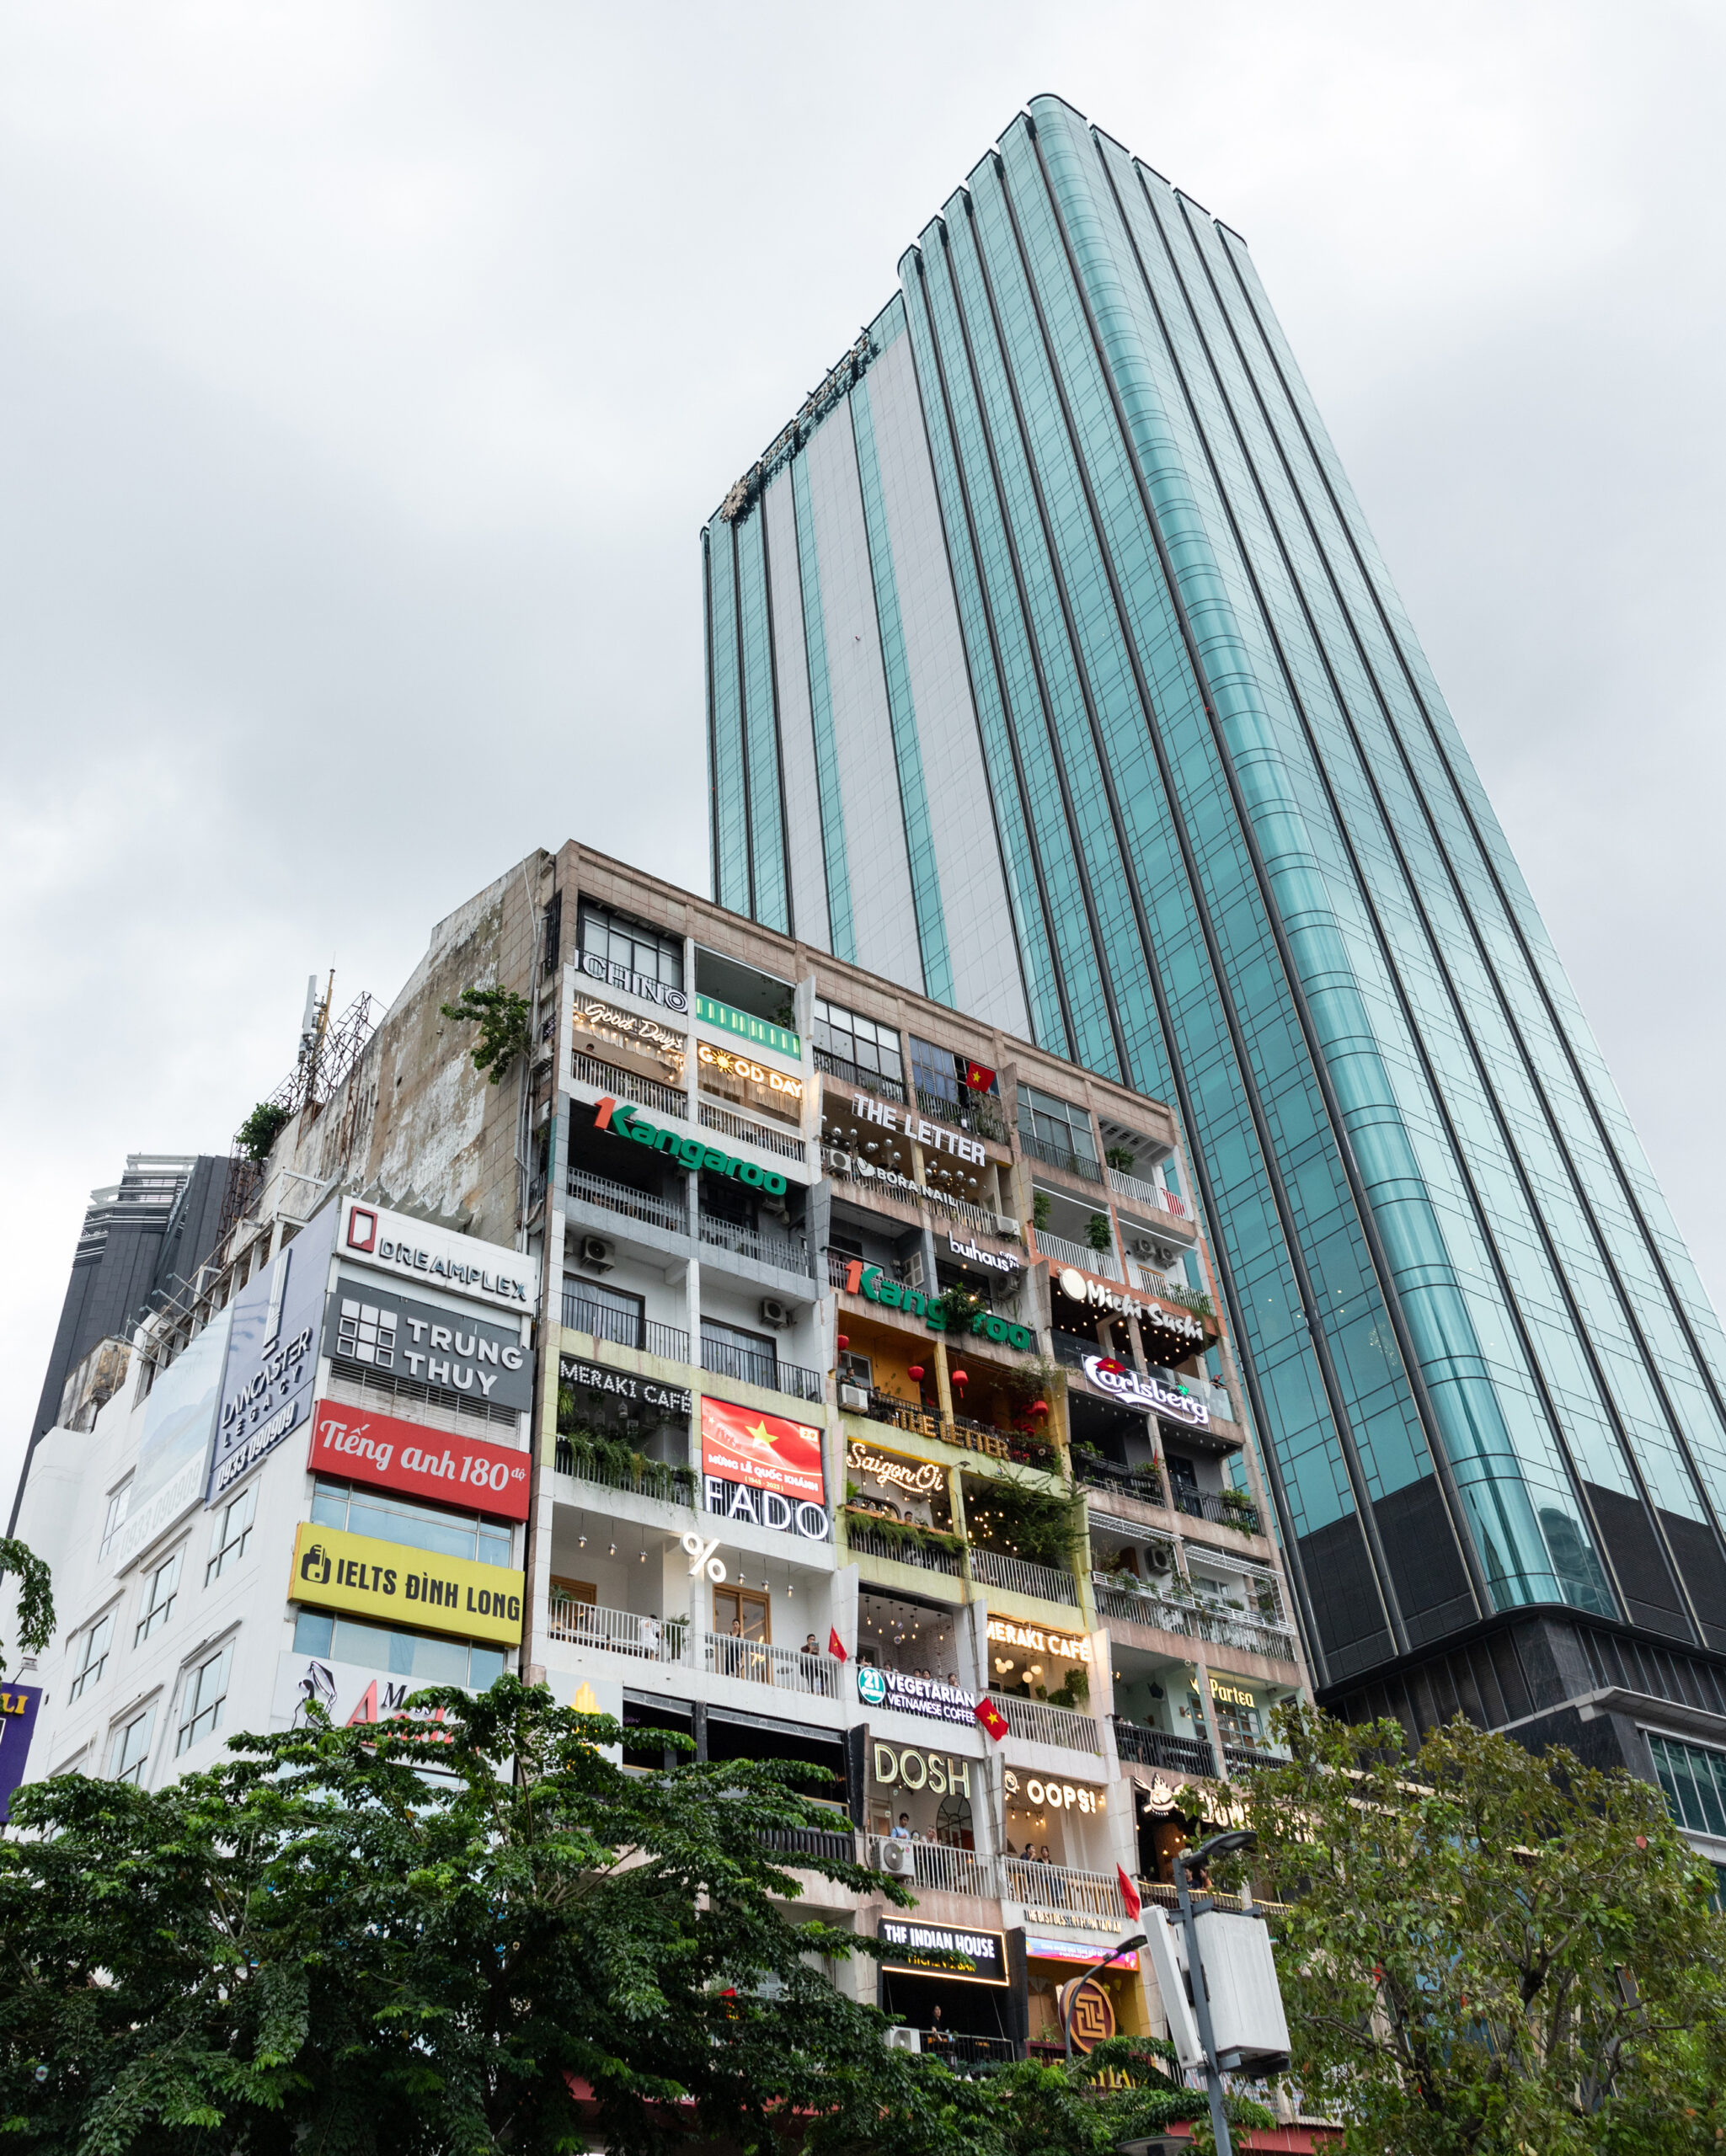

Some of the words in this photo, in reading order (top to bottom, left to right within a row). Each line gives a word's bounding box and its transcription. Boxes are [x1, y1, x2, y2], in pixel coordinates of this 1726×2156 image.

[585, 1004, 634, 1031] Good
[639, 1020, 683, 1050] Days
[853, 1093, 896, 1131] THE
[905, 1113, 985, 1166] LETTER
[876, 1167, 919, 1193] BORA
[379, 1237, 526, 1301] DREAMPLEX
[1086, 1279, 1141, 1319] Michi
[1147, 1302, 1203, 1341] Sushi
[407, 1317, 523, 1369] TRUNG
[222, 1326, 313, 1429] LANCASTER
[403, 1349, 498, 1396] THUY
[560, 1360, 637, 1398] MERAKI
[644, 1385, 692, 1414] CAFÉ
[1084, 1355, 1209, 1423] Carlsberg
[895, 1407, 937, 1438] THE
[216, 1444, 248, 1491] 0933
[320, 1420, 393, 1471] Tiếng
[401, 1447, 456, 1480] anh
[460, 1455, 509, 1491] 180
[847, 1443, 923, 1492] Saigon
[704, 1476, 829, 1540] FADO
[336, 1558, 397, 1595] IELTS
[405, 1572, 458, 1609] ĐÌNH
[467, 1587, 520, 1622] LONG
[863, 1669, 880, 1689] 21
[885, 1673, 975, 1708] VEGETARIAN
[887, 1692, 942, 1716] VIETNAMESE
[943, 1706, 975, 1724] COFFEE
[874, 1743, 970, 1798] DOSH
[1026, 1779, 1096, 1814] OOPS!
[910, 1928, 953, 1951] INDIAN
[954, 1934, 995, 1958] HOUSE
